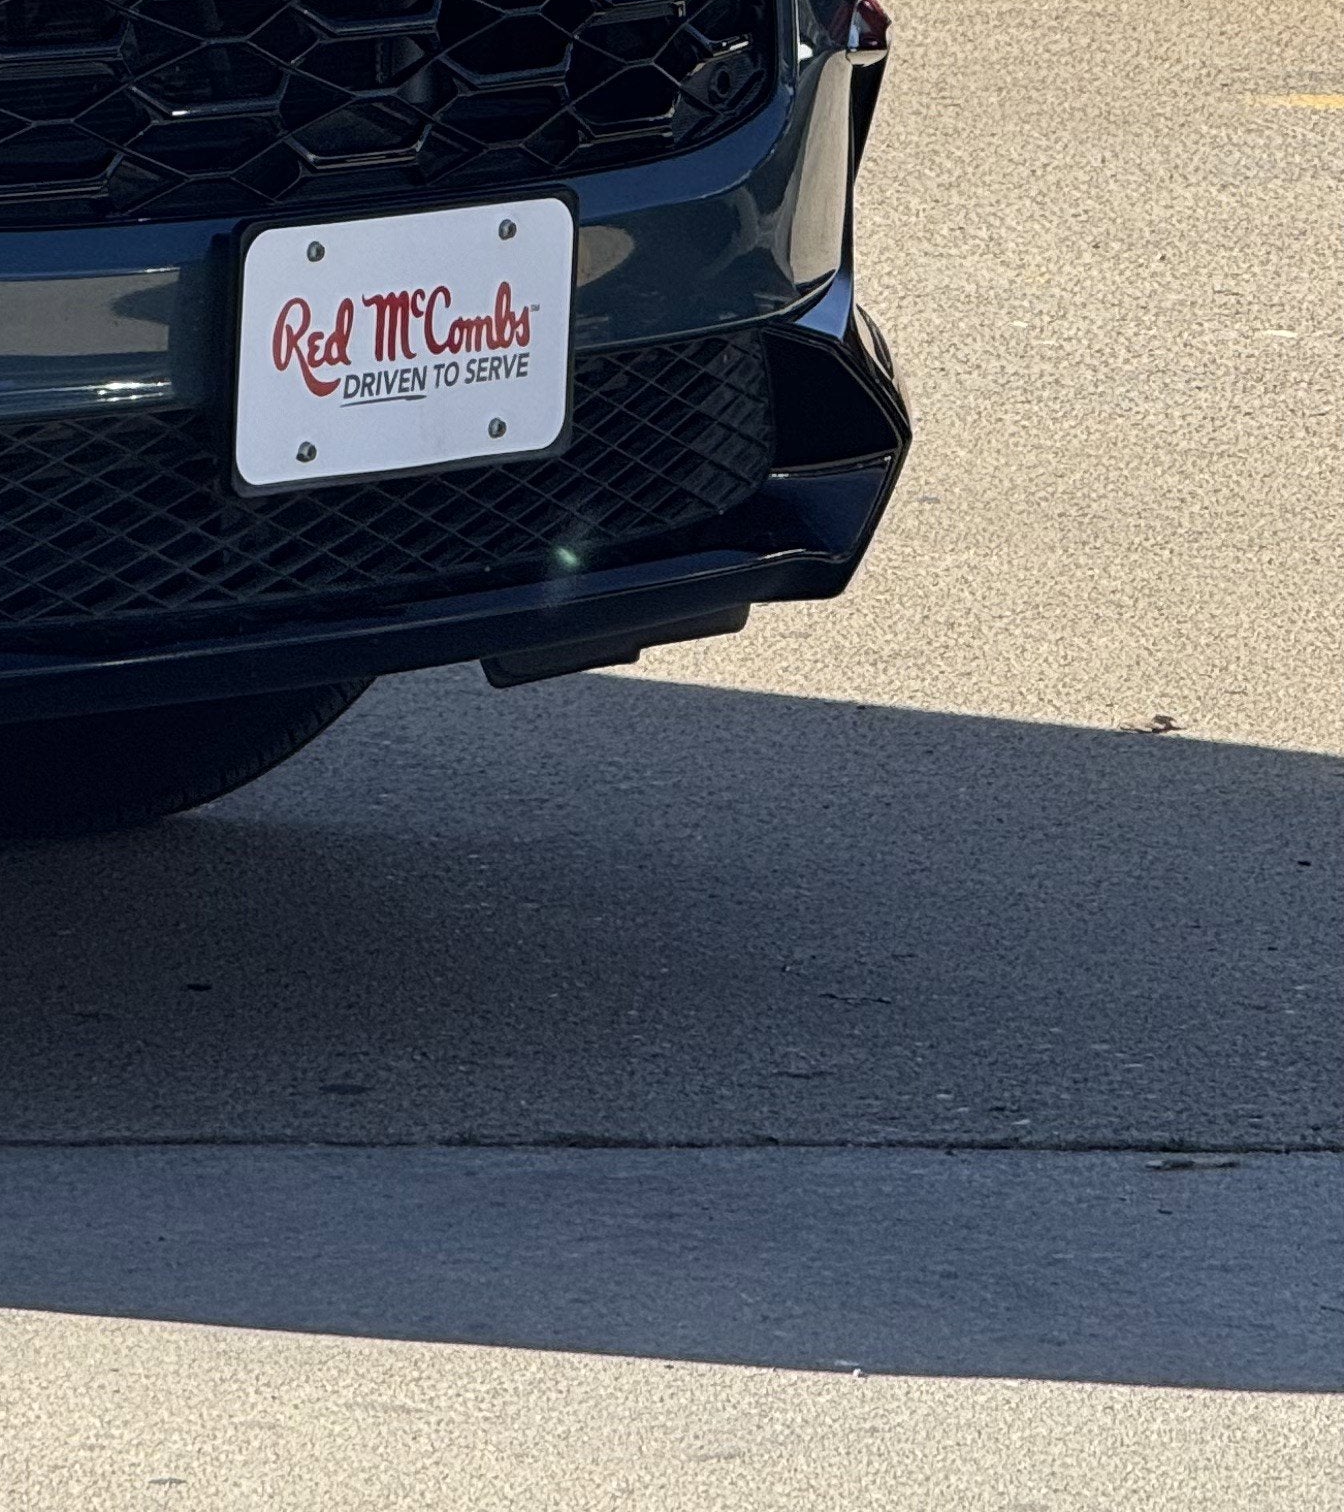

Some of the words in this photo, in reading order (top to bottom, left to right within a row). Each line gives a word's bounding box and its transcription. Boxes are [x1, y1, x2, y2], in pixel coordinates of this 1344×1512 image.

[272, 297, 355, 398] Red
[362, 281, 531, 361] McCombs
[342, 372, 427, 400] DRIVEN
[433, 361, 461, 390] TO
[464, 351, 531, 386] SERVE
